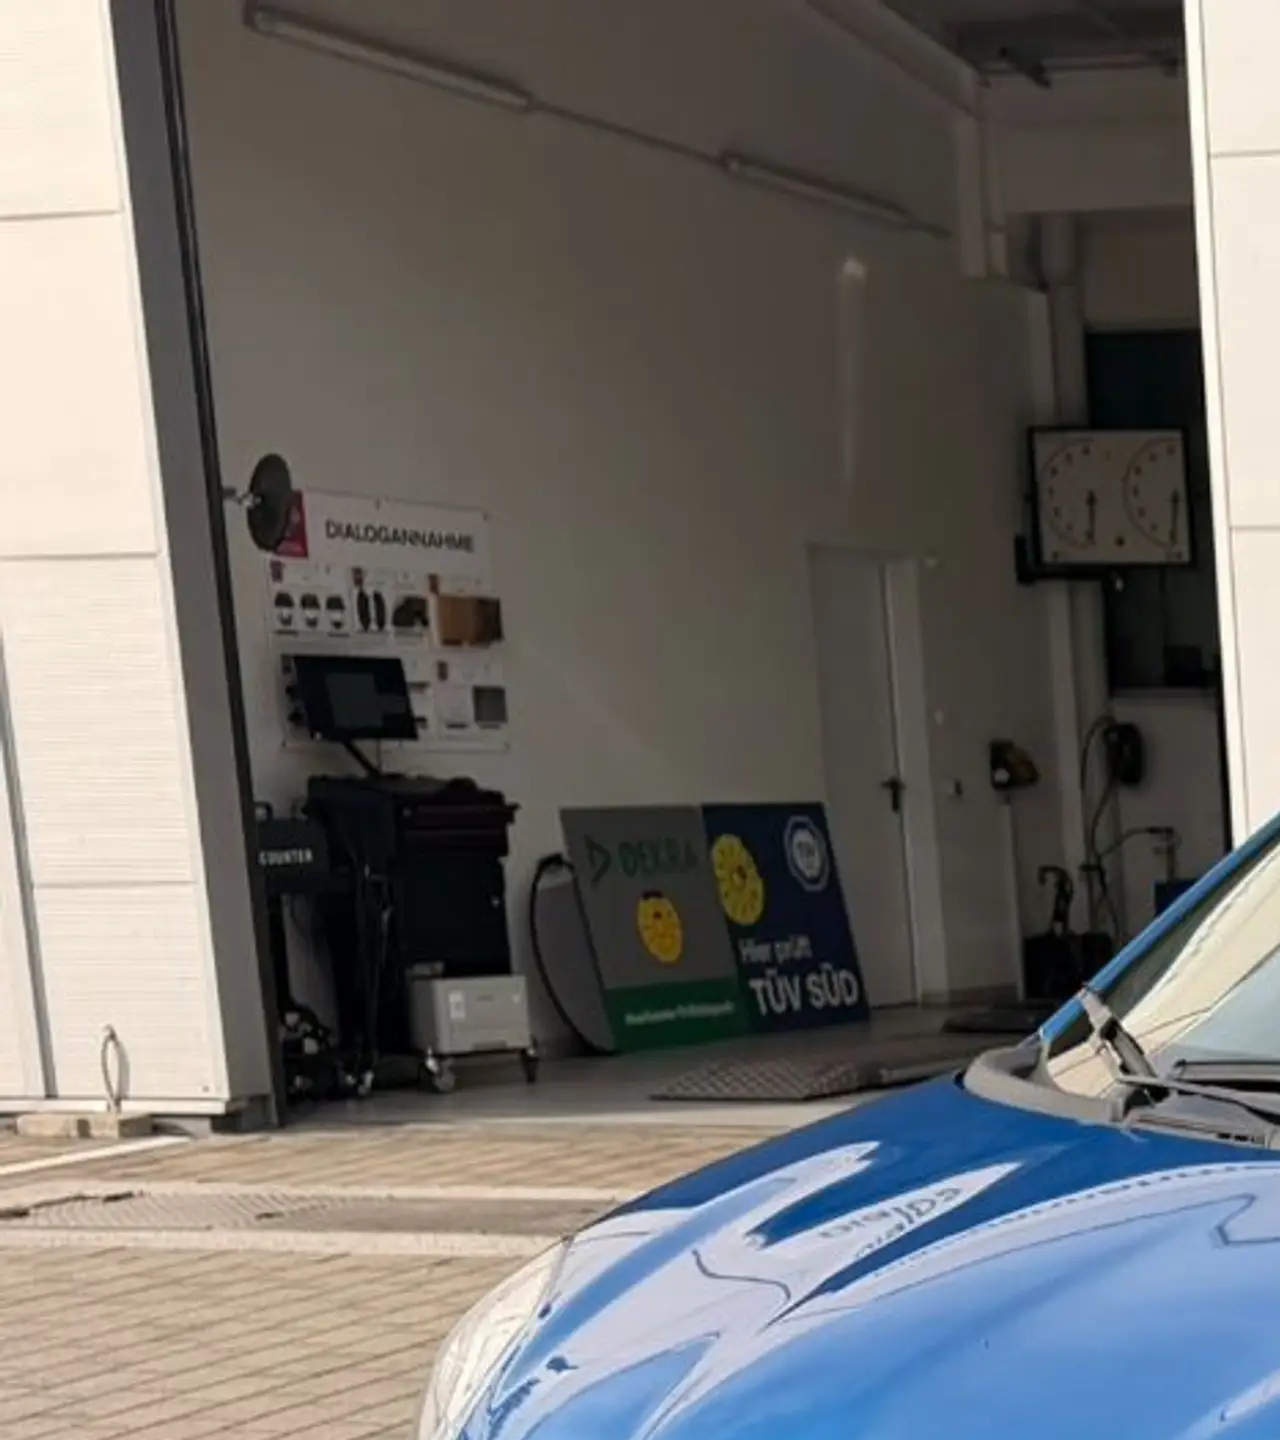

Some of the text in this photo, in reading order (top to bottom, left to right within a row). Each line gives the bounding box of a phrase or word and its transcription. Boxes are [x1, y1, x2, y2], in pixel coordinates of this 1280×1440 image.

[325, 519, 474, 553] DIALOGANNAHME
[748, 967, 802, 1017] TÜV
[805, 961, 860, 1010] SÜD
